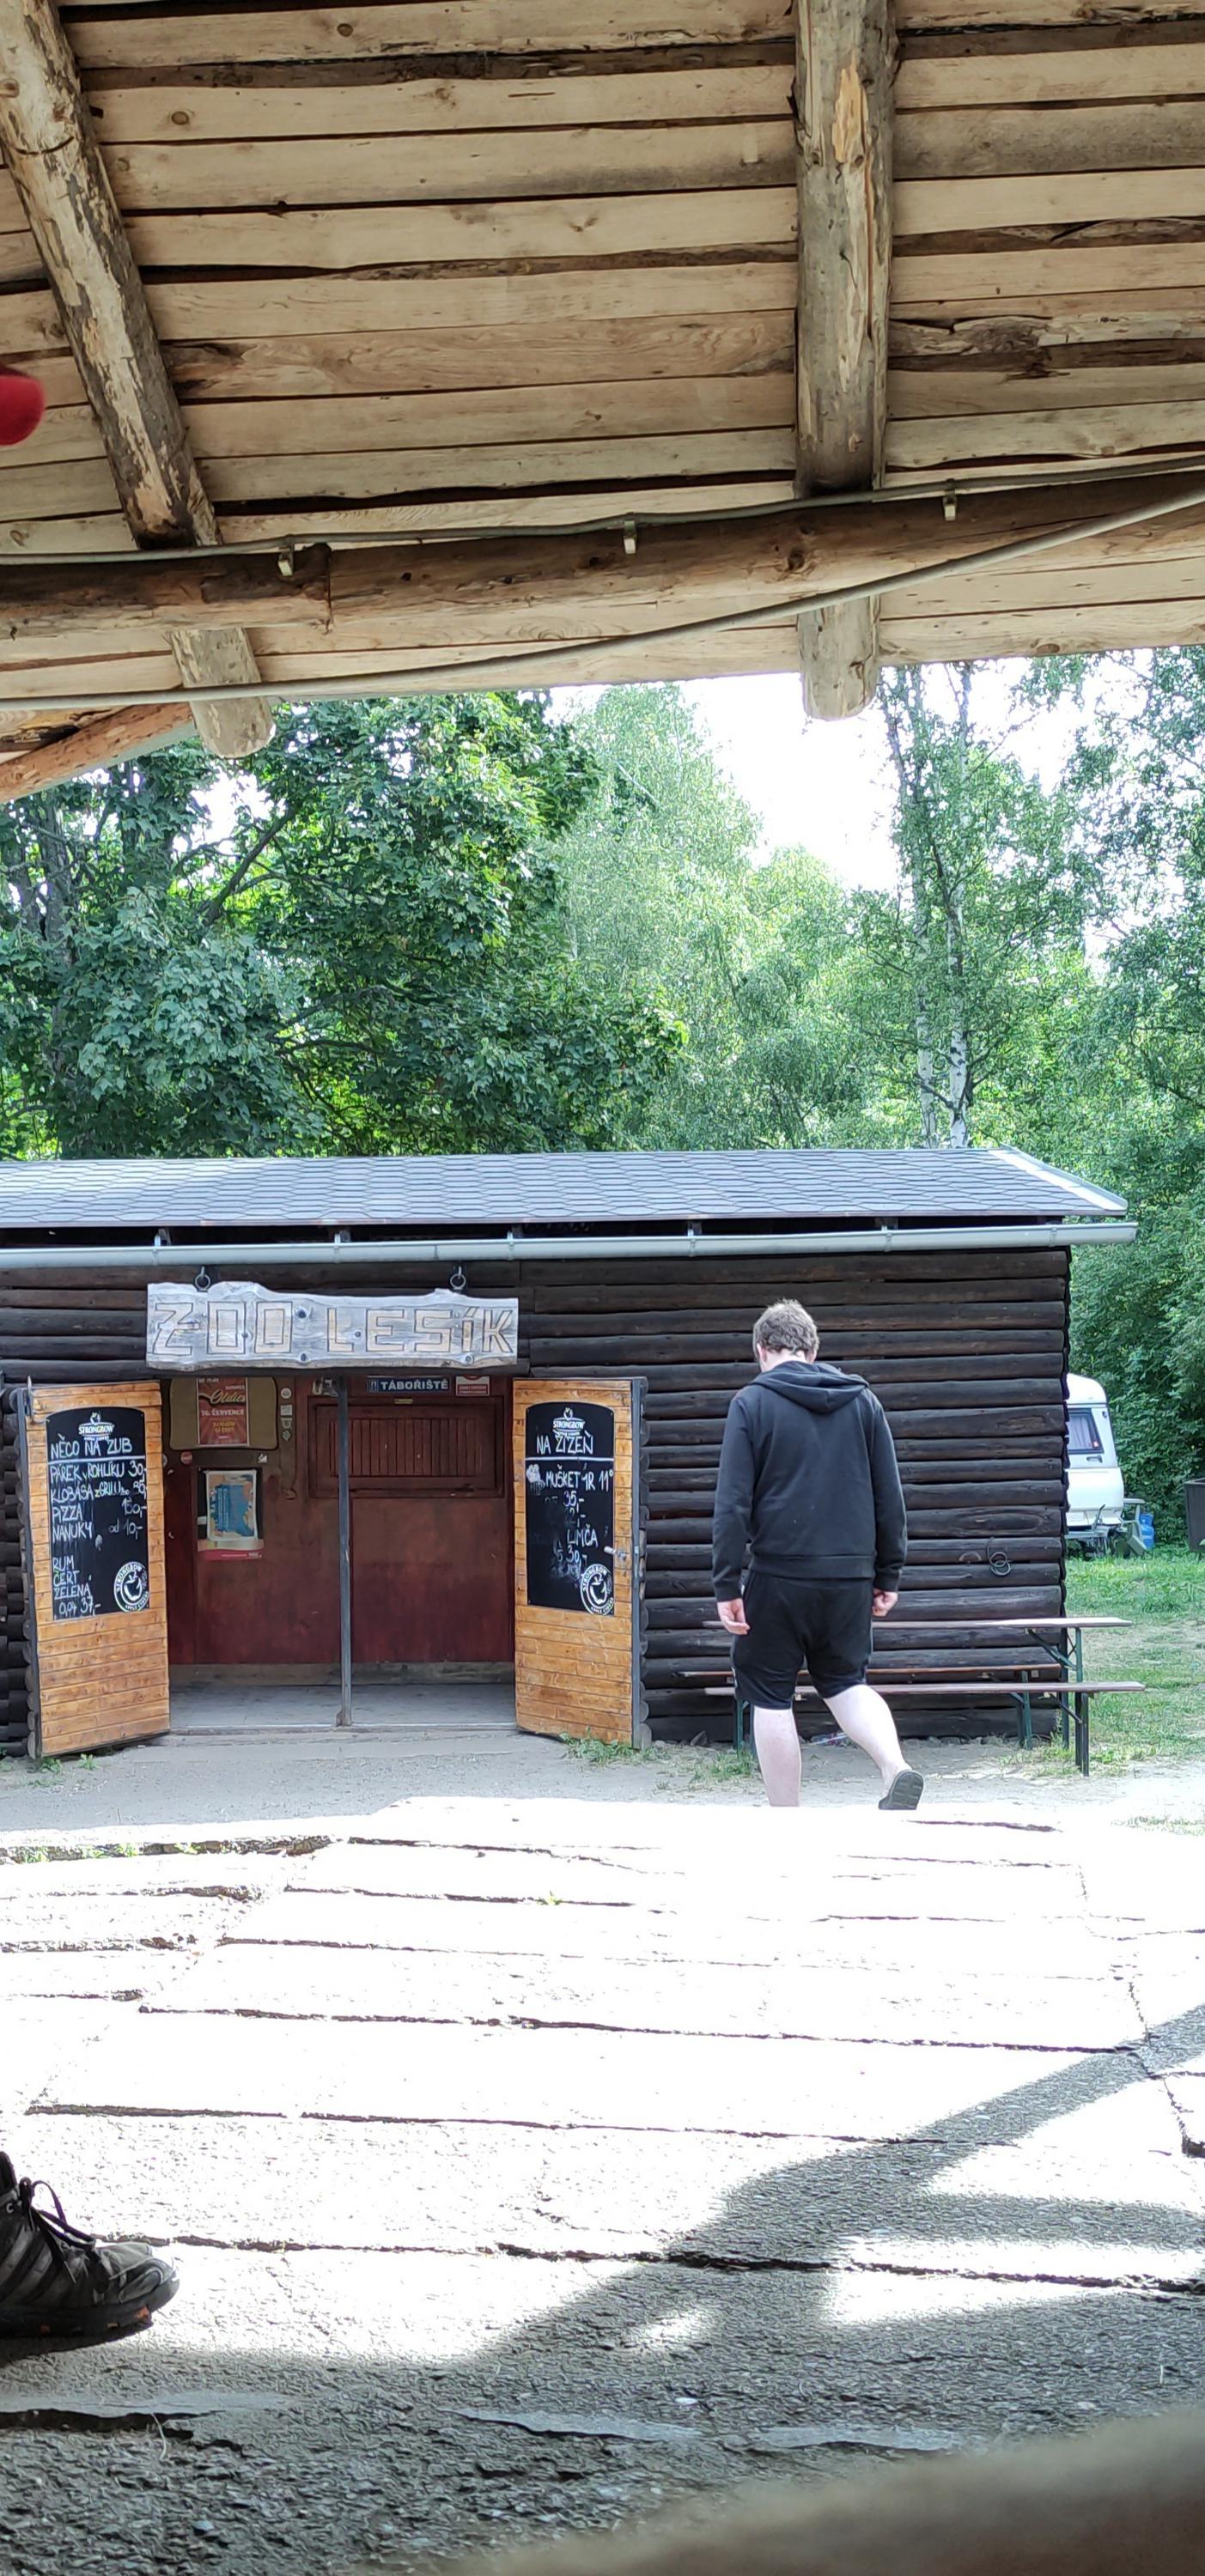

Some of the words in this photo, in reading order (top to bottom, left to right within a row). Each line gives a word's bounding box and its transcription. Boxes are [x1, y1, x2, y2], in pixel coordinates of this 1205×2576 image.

[152, 1300, 293, 1357] ZOO
[326, 1306, 514, 1354] LESÍK
[51, 1433, 80, 1460] NĚCO
[84, 1441, 101, 1456] NA
[107, 1437, 133, 1455] ZUB
[536, 1435, 551, 1455] NA
[52, 1504, 82, 1524] PIZZA
[52, 1555, 75, 1573] RUM
[53, 1570, 80, 1588] ČERT
